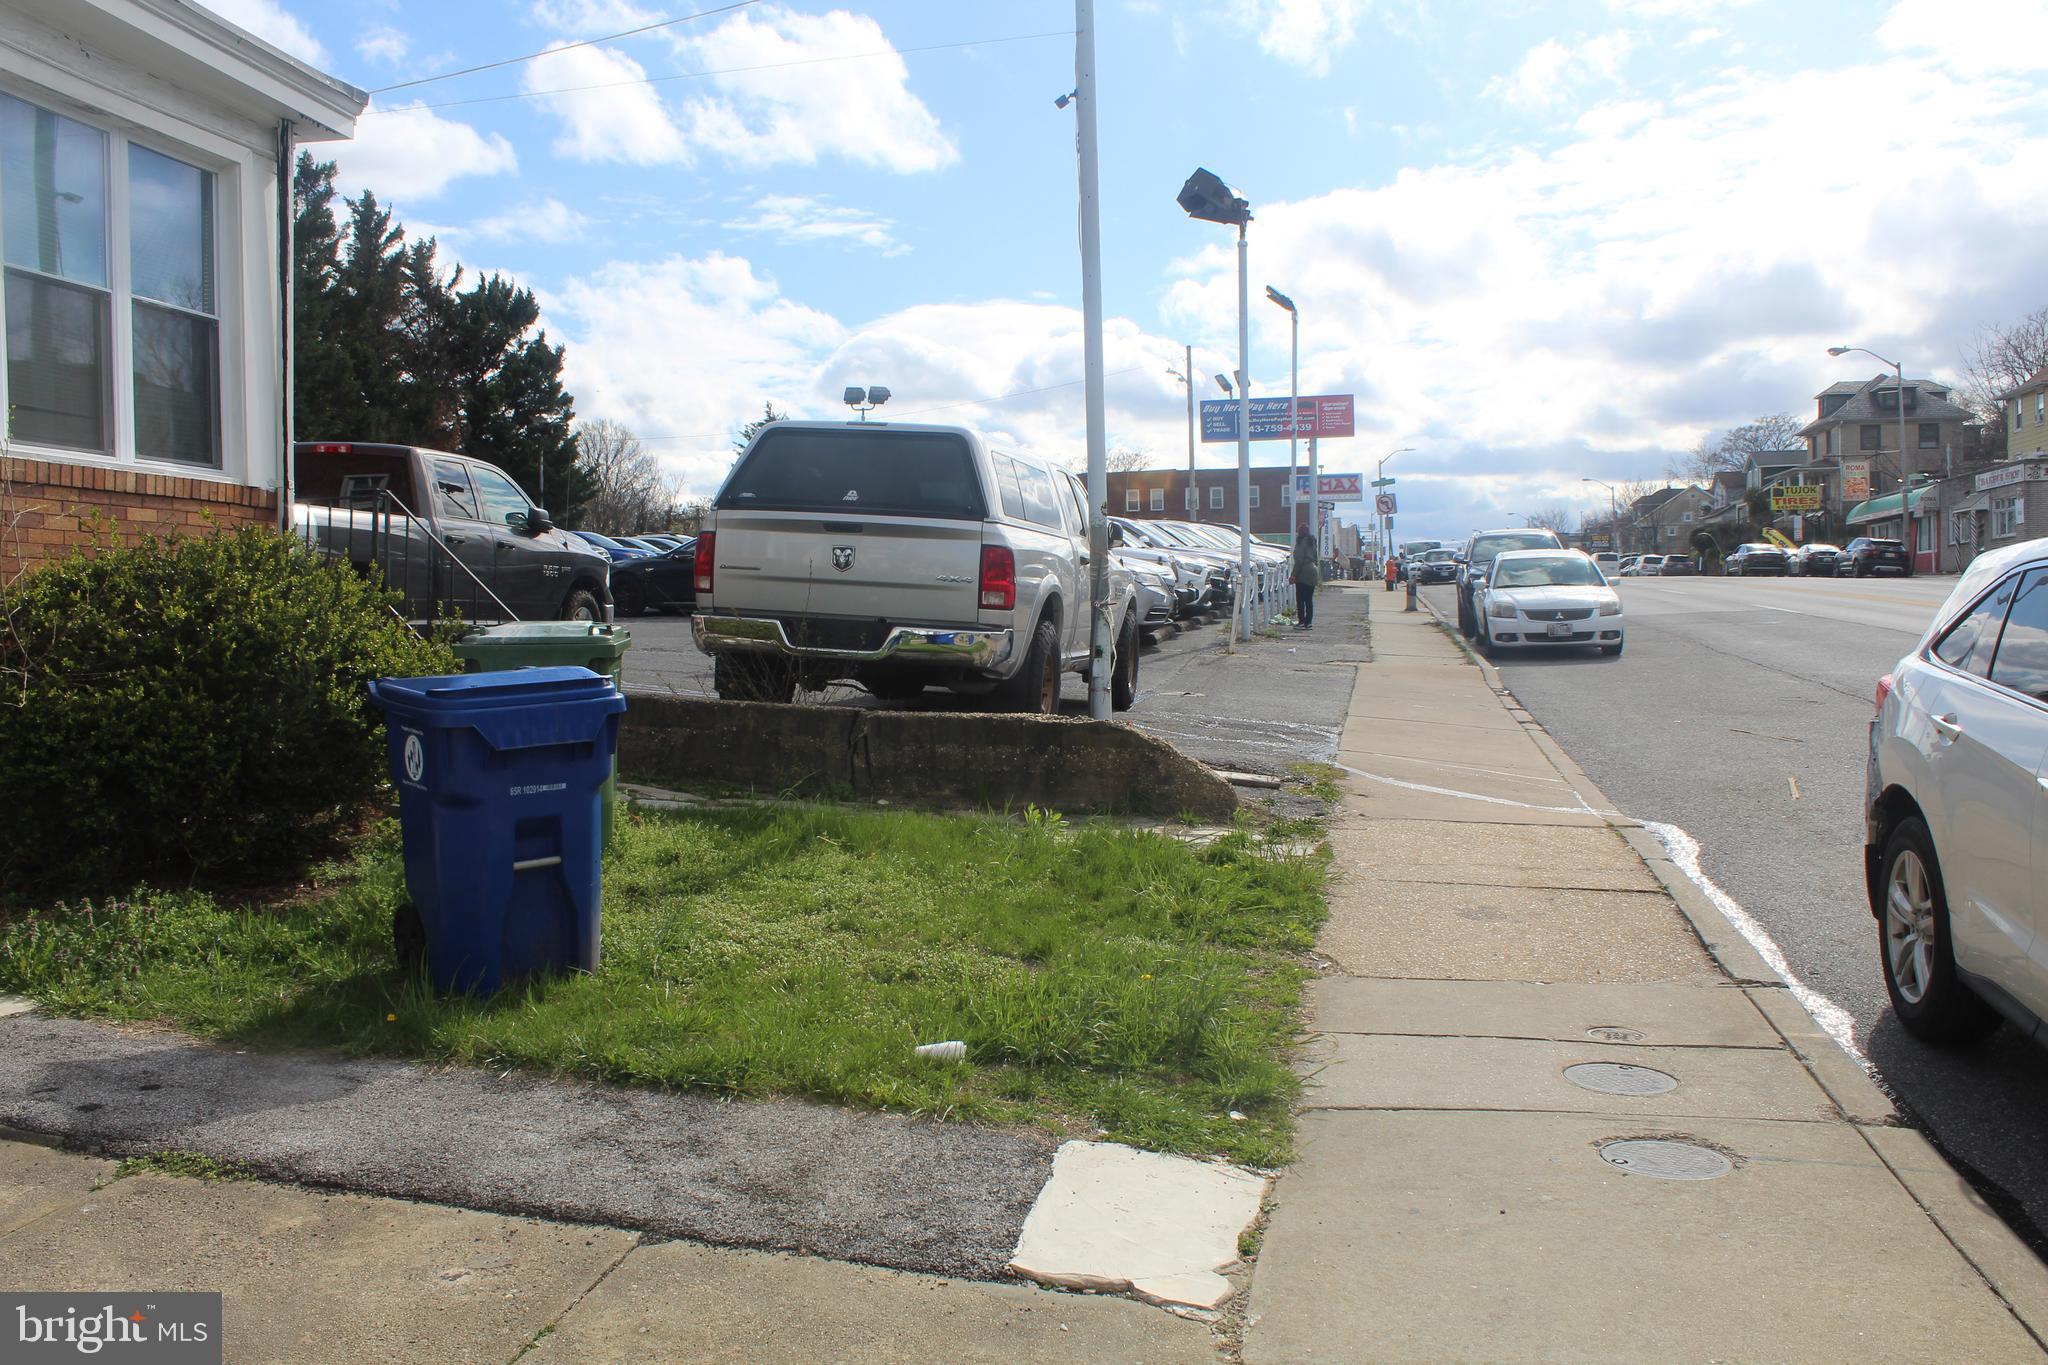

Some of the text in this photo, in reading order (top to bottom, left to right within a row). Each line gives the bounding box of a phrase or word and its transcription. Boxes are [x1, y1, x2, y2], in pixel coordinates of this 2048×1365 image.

[1203, 404, 1221, 413] Buy
[1223, 403, 1241, 412] Her
[1266, 402, 1289, 410] Here
[1249, 423, 1312, 433] 43-759-439
[1785, 486, 1817, 494] TUJOK
[1773, 496, 1818, 505] TIRES
